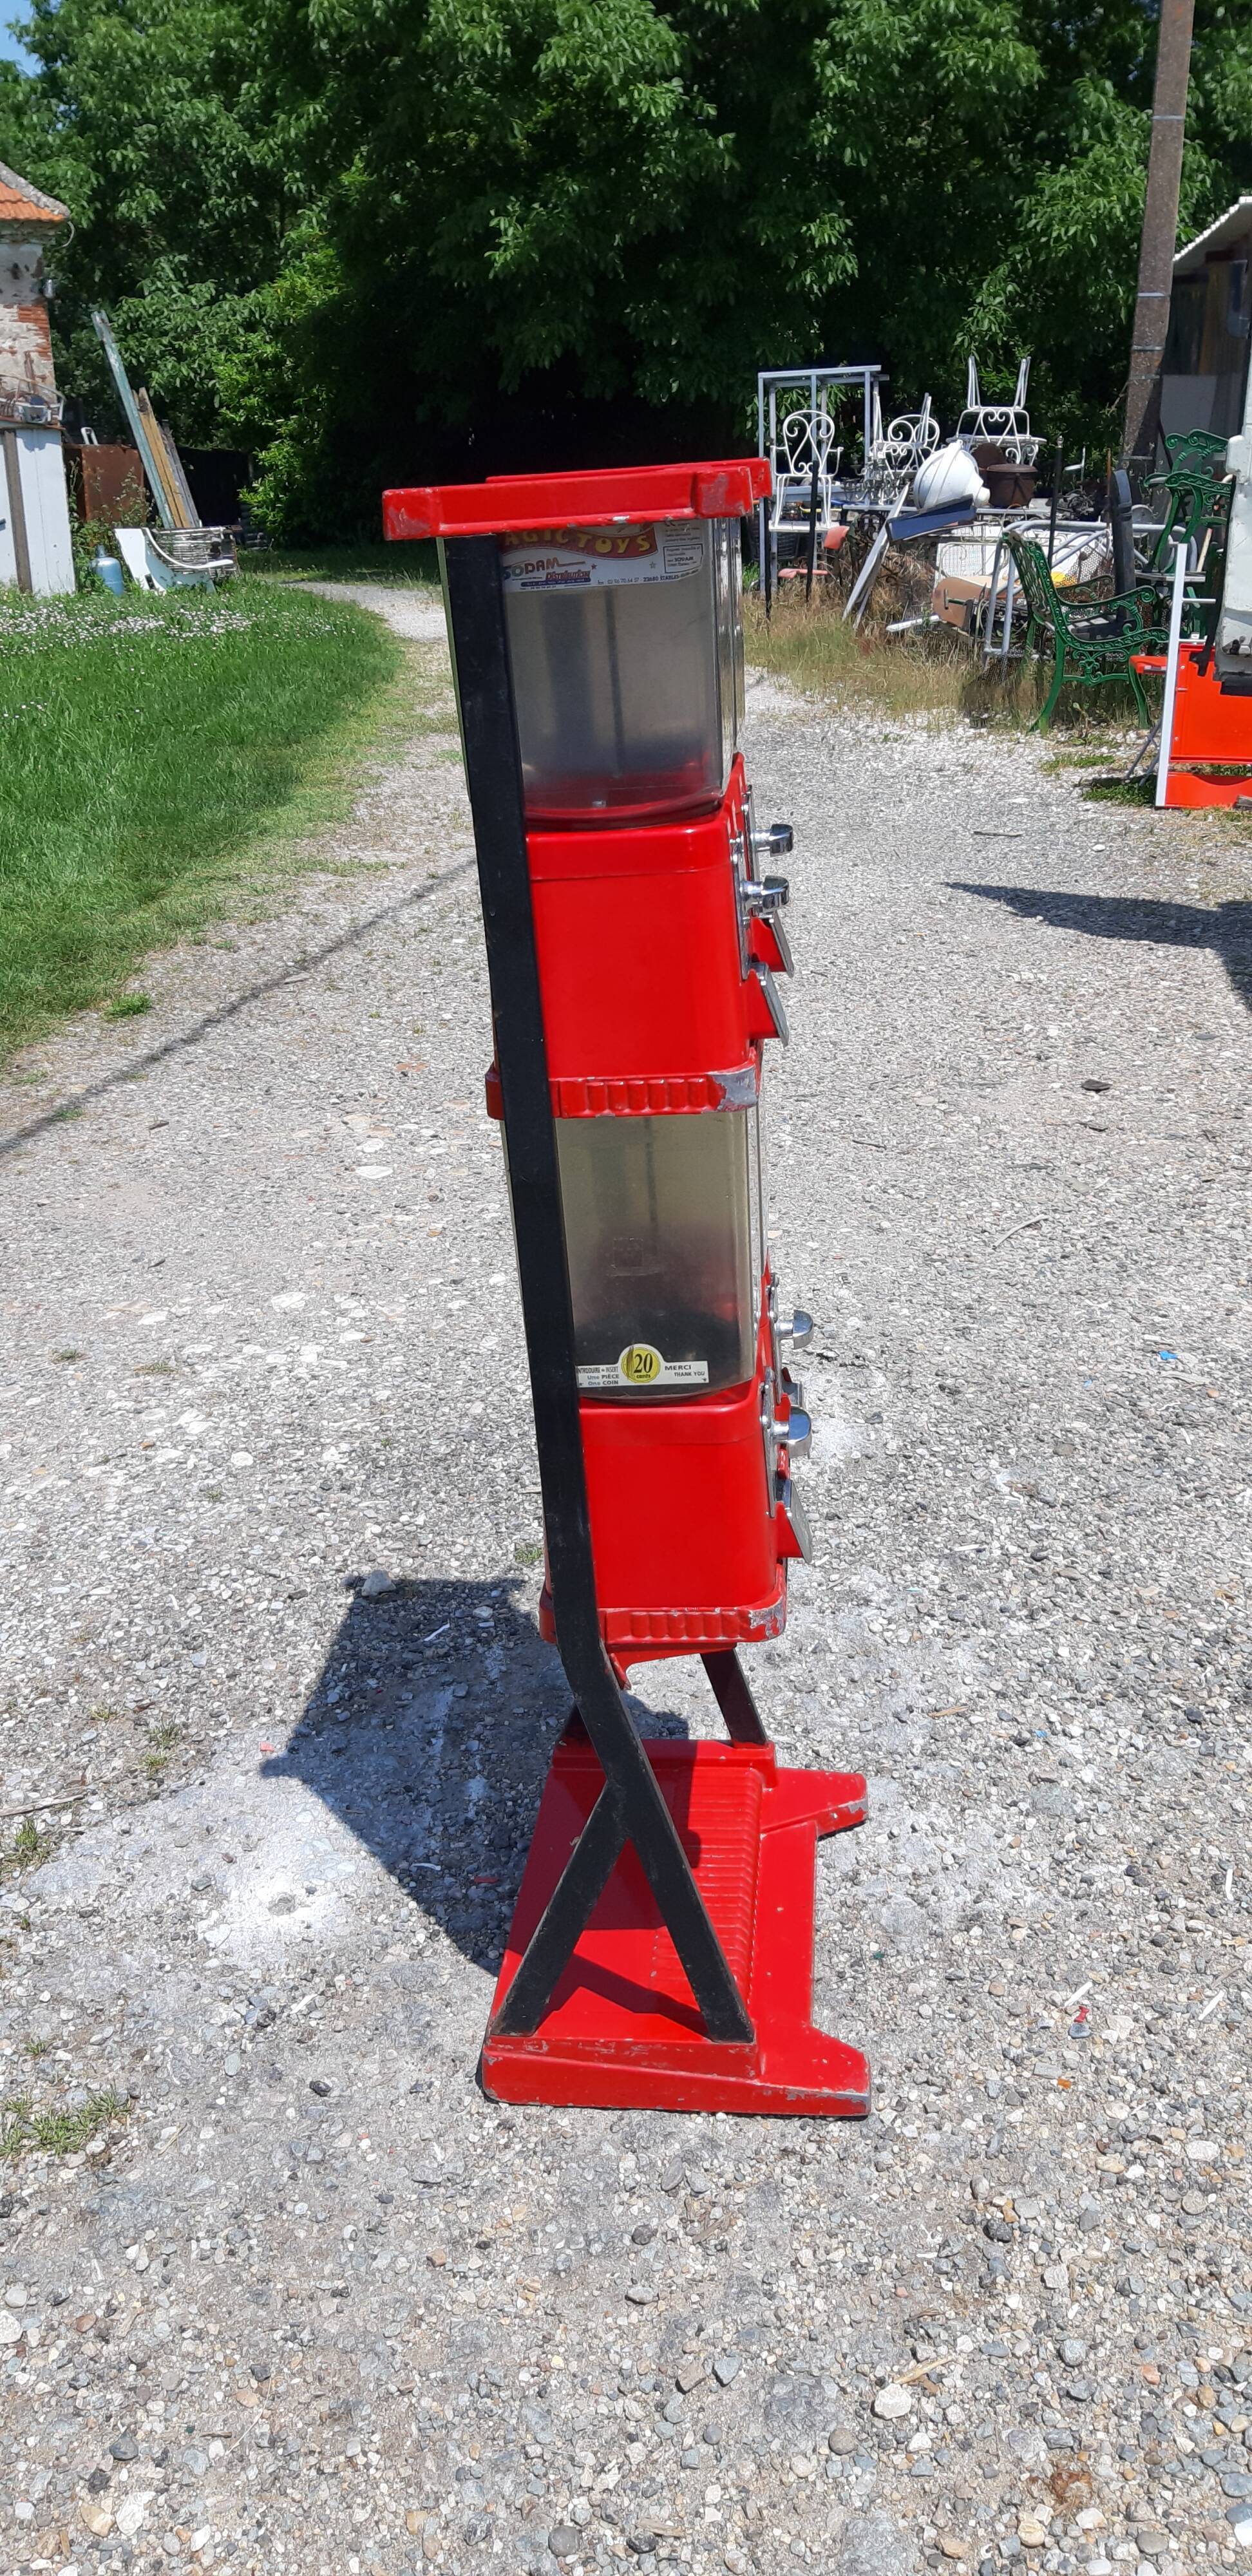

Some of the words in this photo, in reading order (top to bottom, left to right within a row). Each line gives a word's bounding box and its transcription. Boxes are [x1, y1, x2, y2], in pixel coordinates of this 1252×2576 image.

[504, 528, 569, 546] AGIC
[576, 532, 650, 553] TOYS
[634, 1353, 653, 1373] 20
